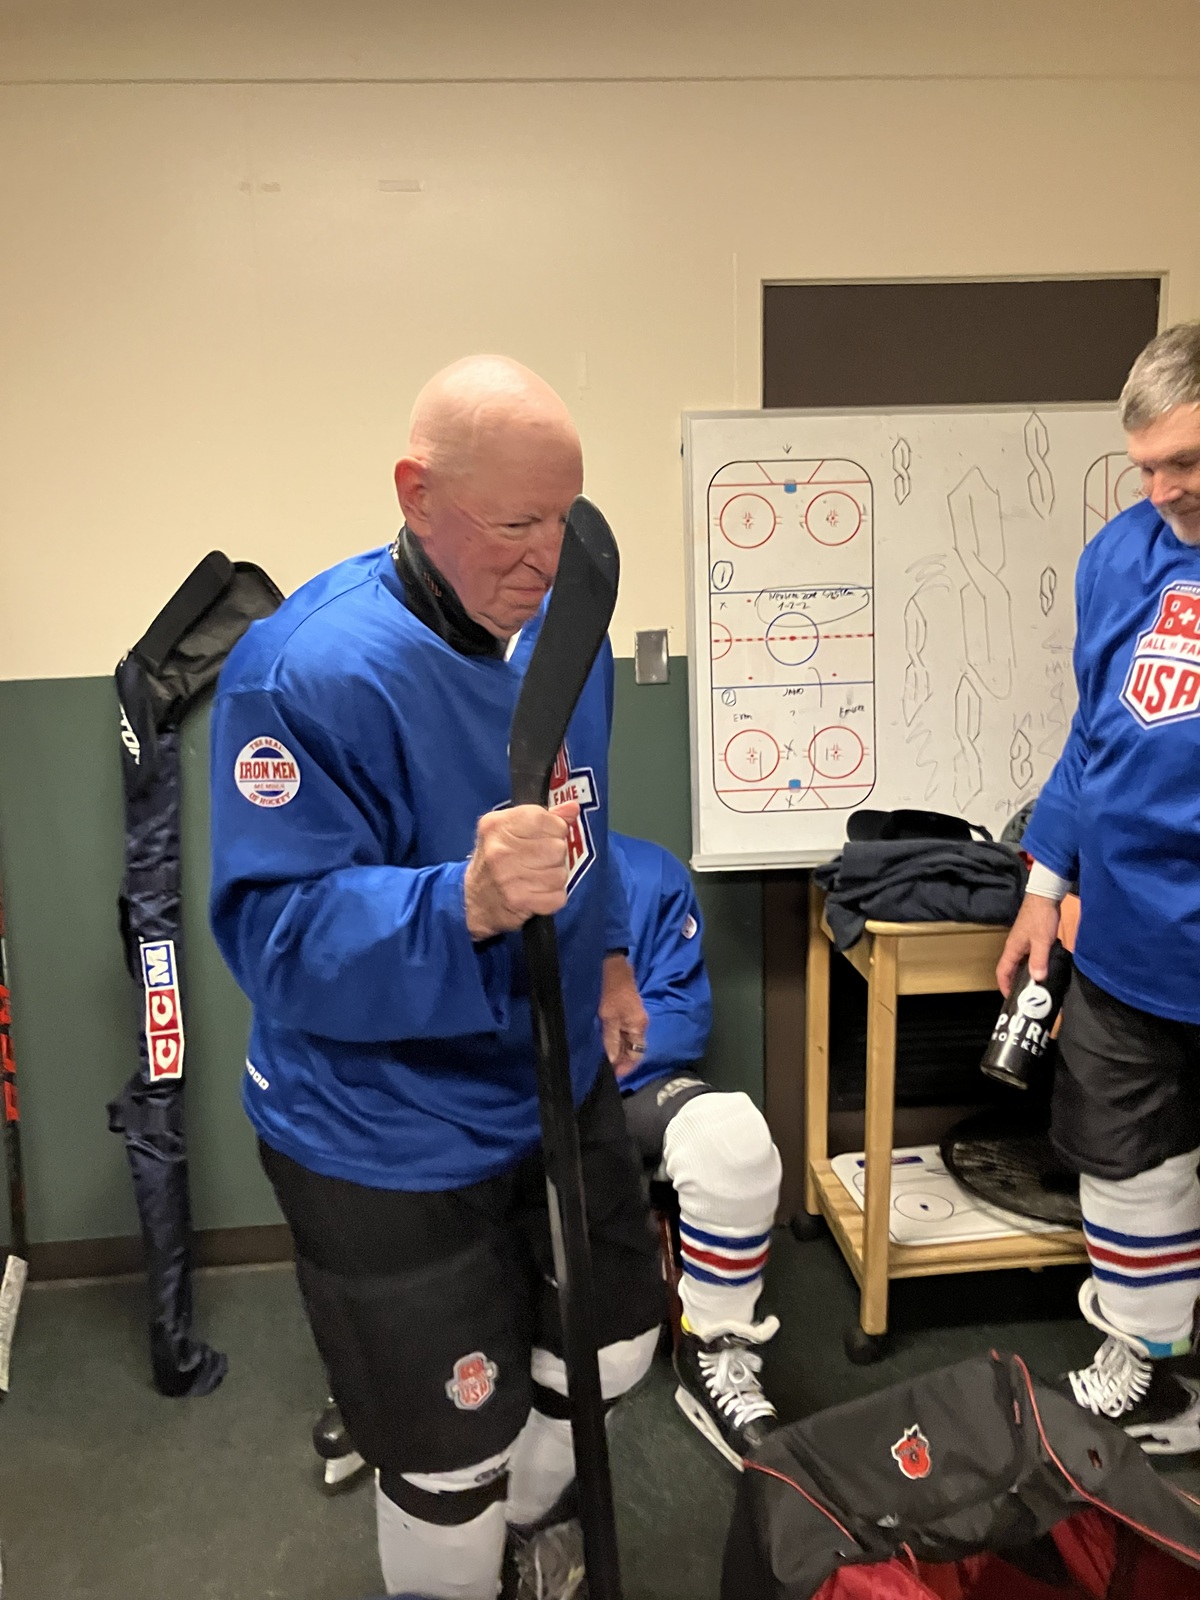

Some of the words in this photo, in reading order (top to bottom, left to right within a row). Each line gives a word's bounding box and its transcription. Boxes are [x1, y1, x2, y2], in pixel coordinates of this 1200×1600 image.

[1131, 663, 1200, 715] USA
[239, 761, 269, 779] IRON
[272, 762, 297, 779] MEN
[553, 785, 579, 806] FAME
[144, 945, 179, 1072] CCM
[995, 1013, 1050, 1049] PURE
